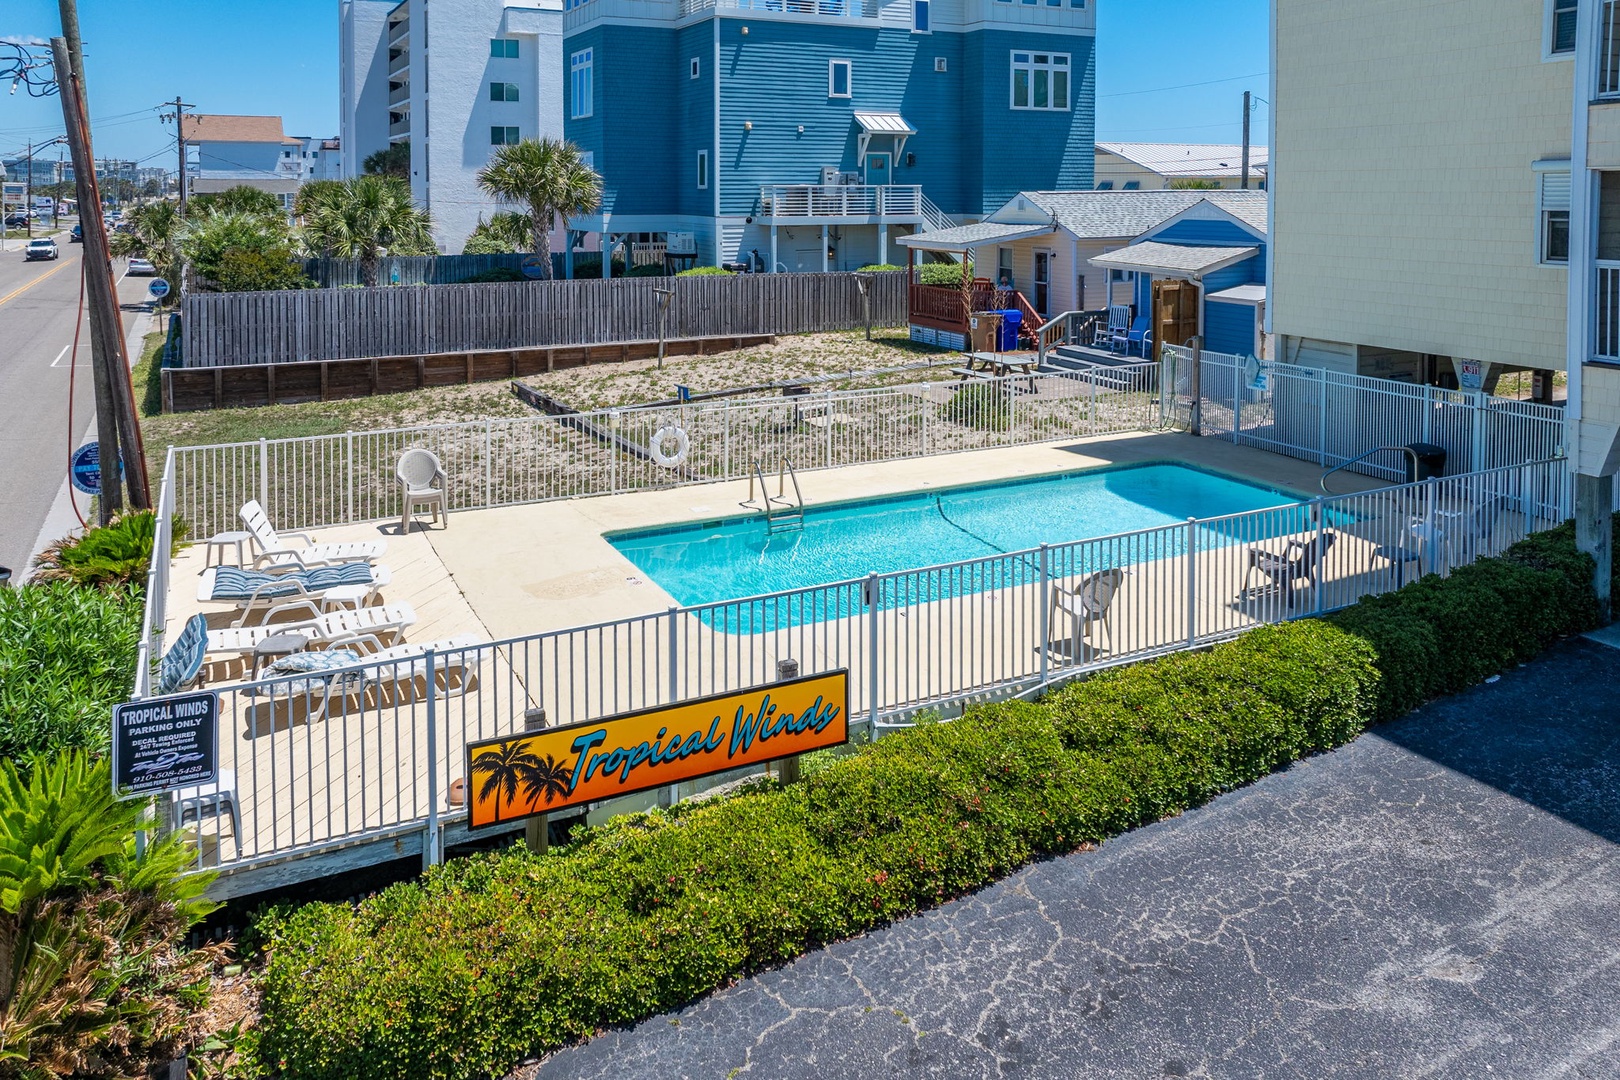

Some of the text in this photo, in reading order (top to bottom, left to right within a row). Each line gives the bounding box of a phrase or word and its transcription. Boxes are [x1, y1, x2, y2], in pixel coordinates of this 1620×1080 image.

[121, 700, 209, 726] TROPICAL WINDS
[128, 718, 202, 736] PARKING ONLY
[132, 731, 196, 746] DECAL REQUIRED
[178, 743, 198, 751] Expense
[570, 694, 840, 792] Tropical Winds
[132, 765, 202, 783] 910-508-5433
[133, 781, 153, 789] PARKING
[153, 778, 169, 786] PERMIT
